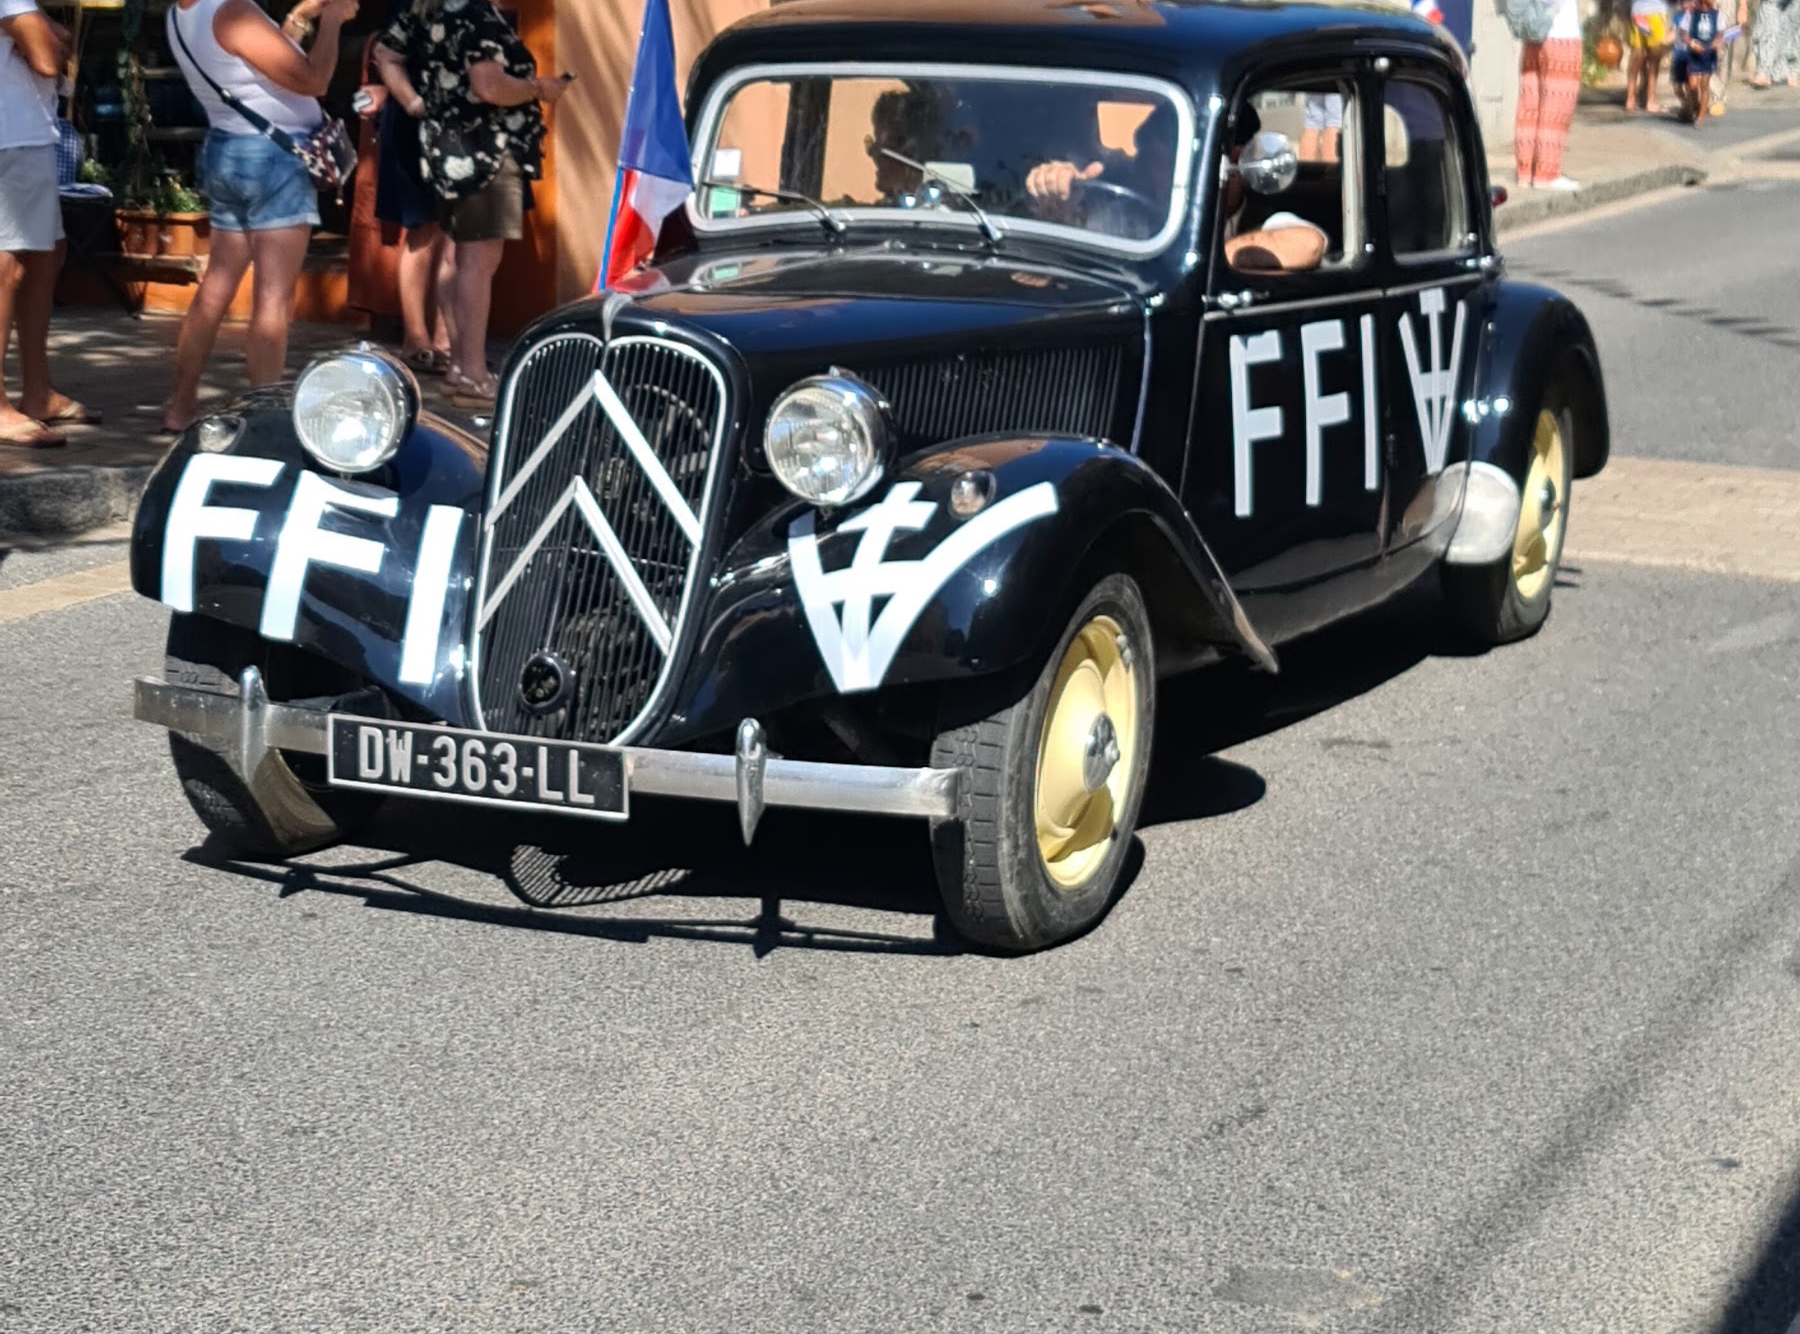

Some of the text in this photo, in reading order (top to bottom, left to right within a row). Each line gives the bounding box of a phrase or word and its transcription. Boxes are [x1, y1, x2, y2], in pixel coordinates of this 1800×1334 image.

[1229, 313, 1379, 517] FFI
[160, 453, 464, 685] FFI
[358, 725, 596, 805] DW-363-LL
